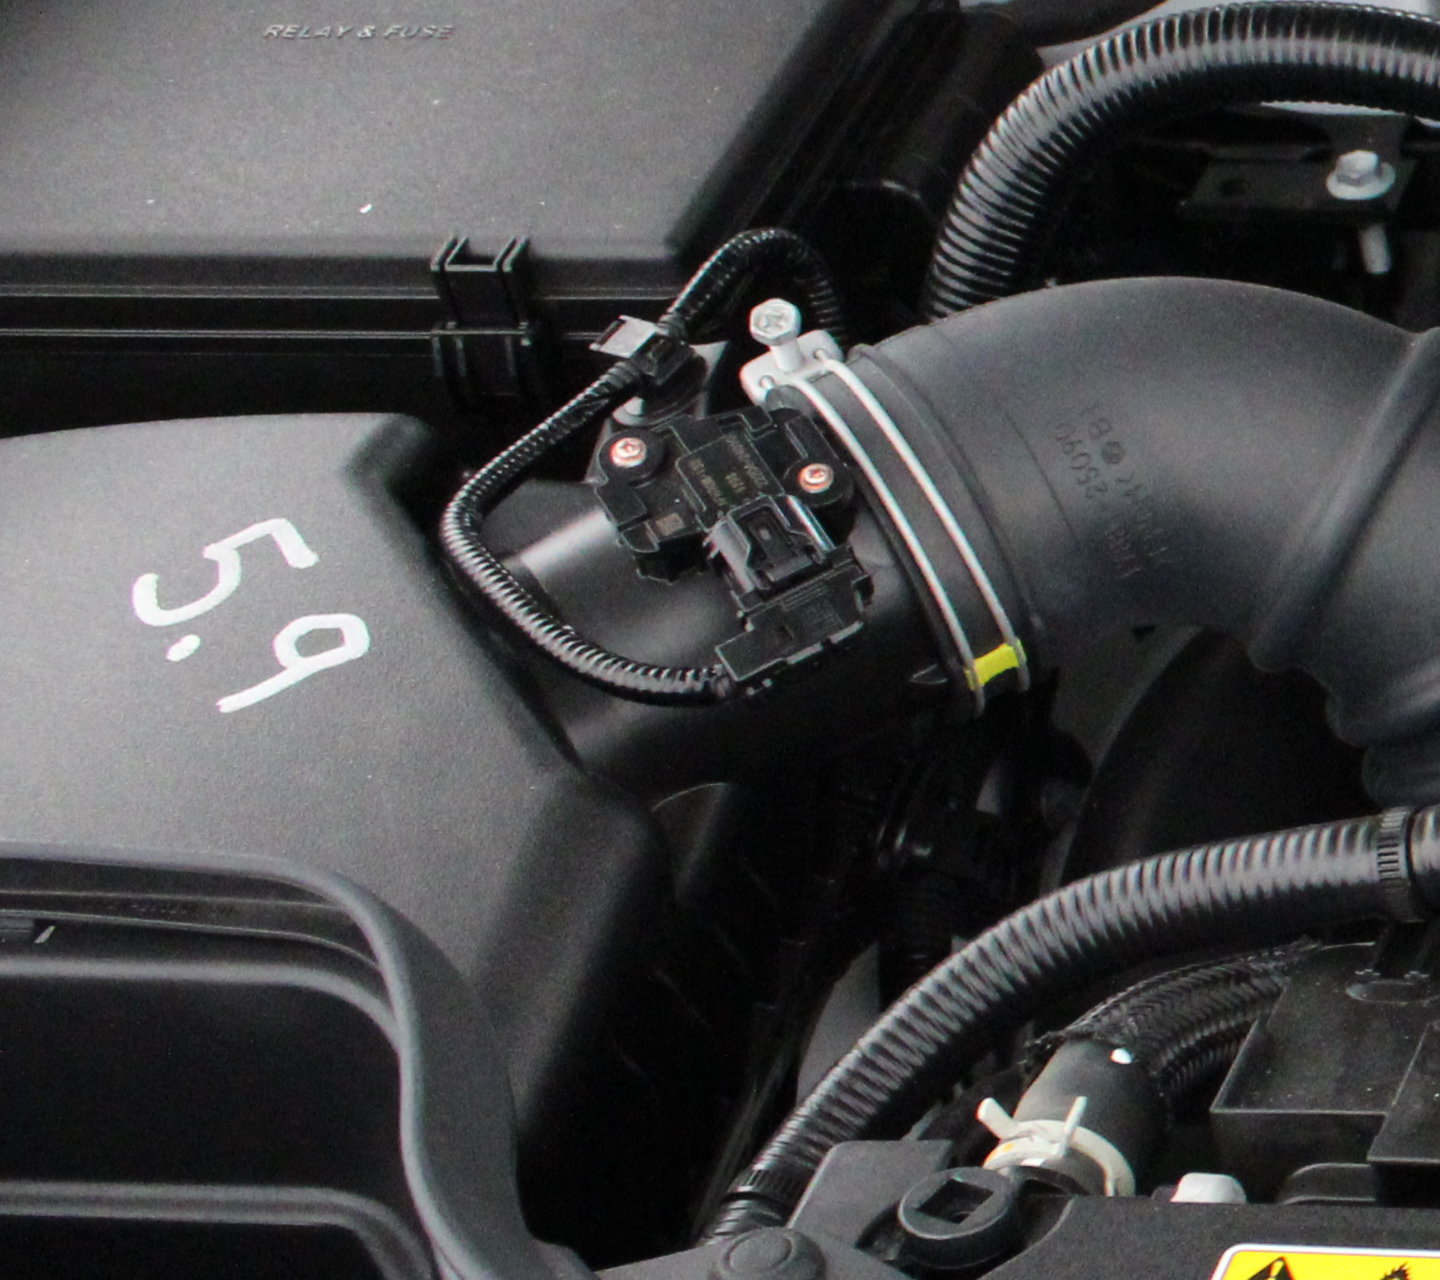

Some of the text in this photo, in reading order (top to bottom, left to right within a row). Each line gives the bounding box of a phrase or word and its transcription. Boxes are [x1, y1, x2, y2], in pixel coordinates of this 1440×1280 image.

[263, 24, 455, 40] RELAY & FUSE
